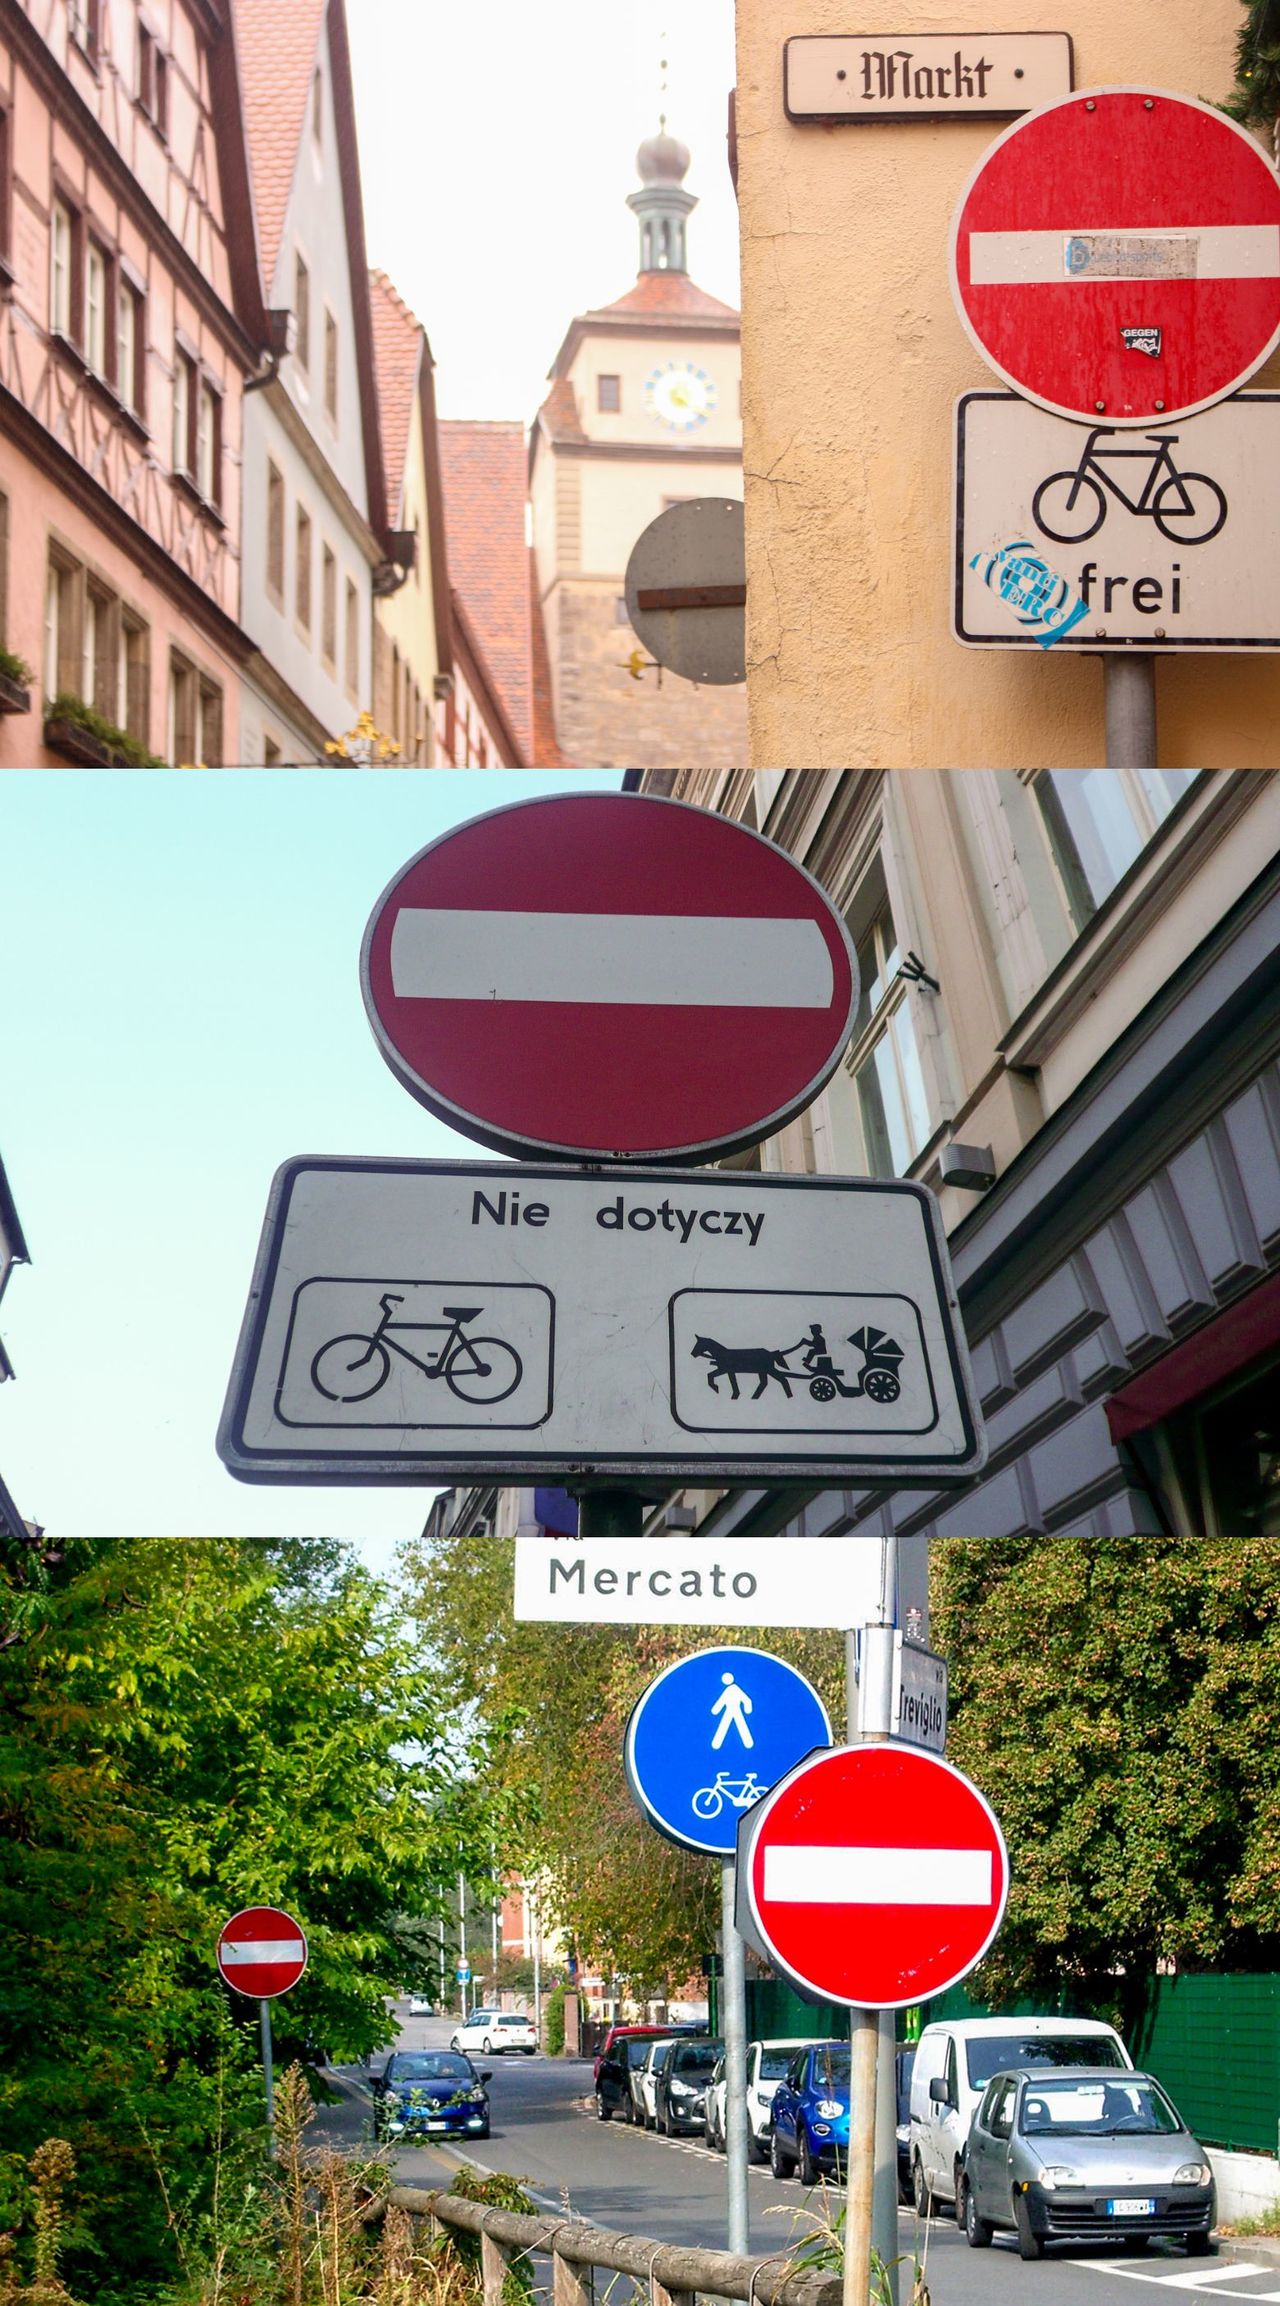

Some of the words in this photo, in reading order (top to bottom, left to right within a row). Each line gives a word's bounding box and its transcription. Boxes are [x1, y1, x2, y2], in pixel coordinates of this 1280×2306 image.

[860, 51, 994, 100] Markt
[1123, 328, 1158, 337] GEGEN
[1078, 563, 1181, 614] frei
[471, 1190, 550, 1227] Nie
[596, 1196, 765, 1246] dotyczy
[549, 1558, 758, 1598] Mercato
[899, 1684, 943, 1736] Treviglio
